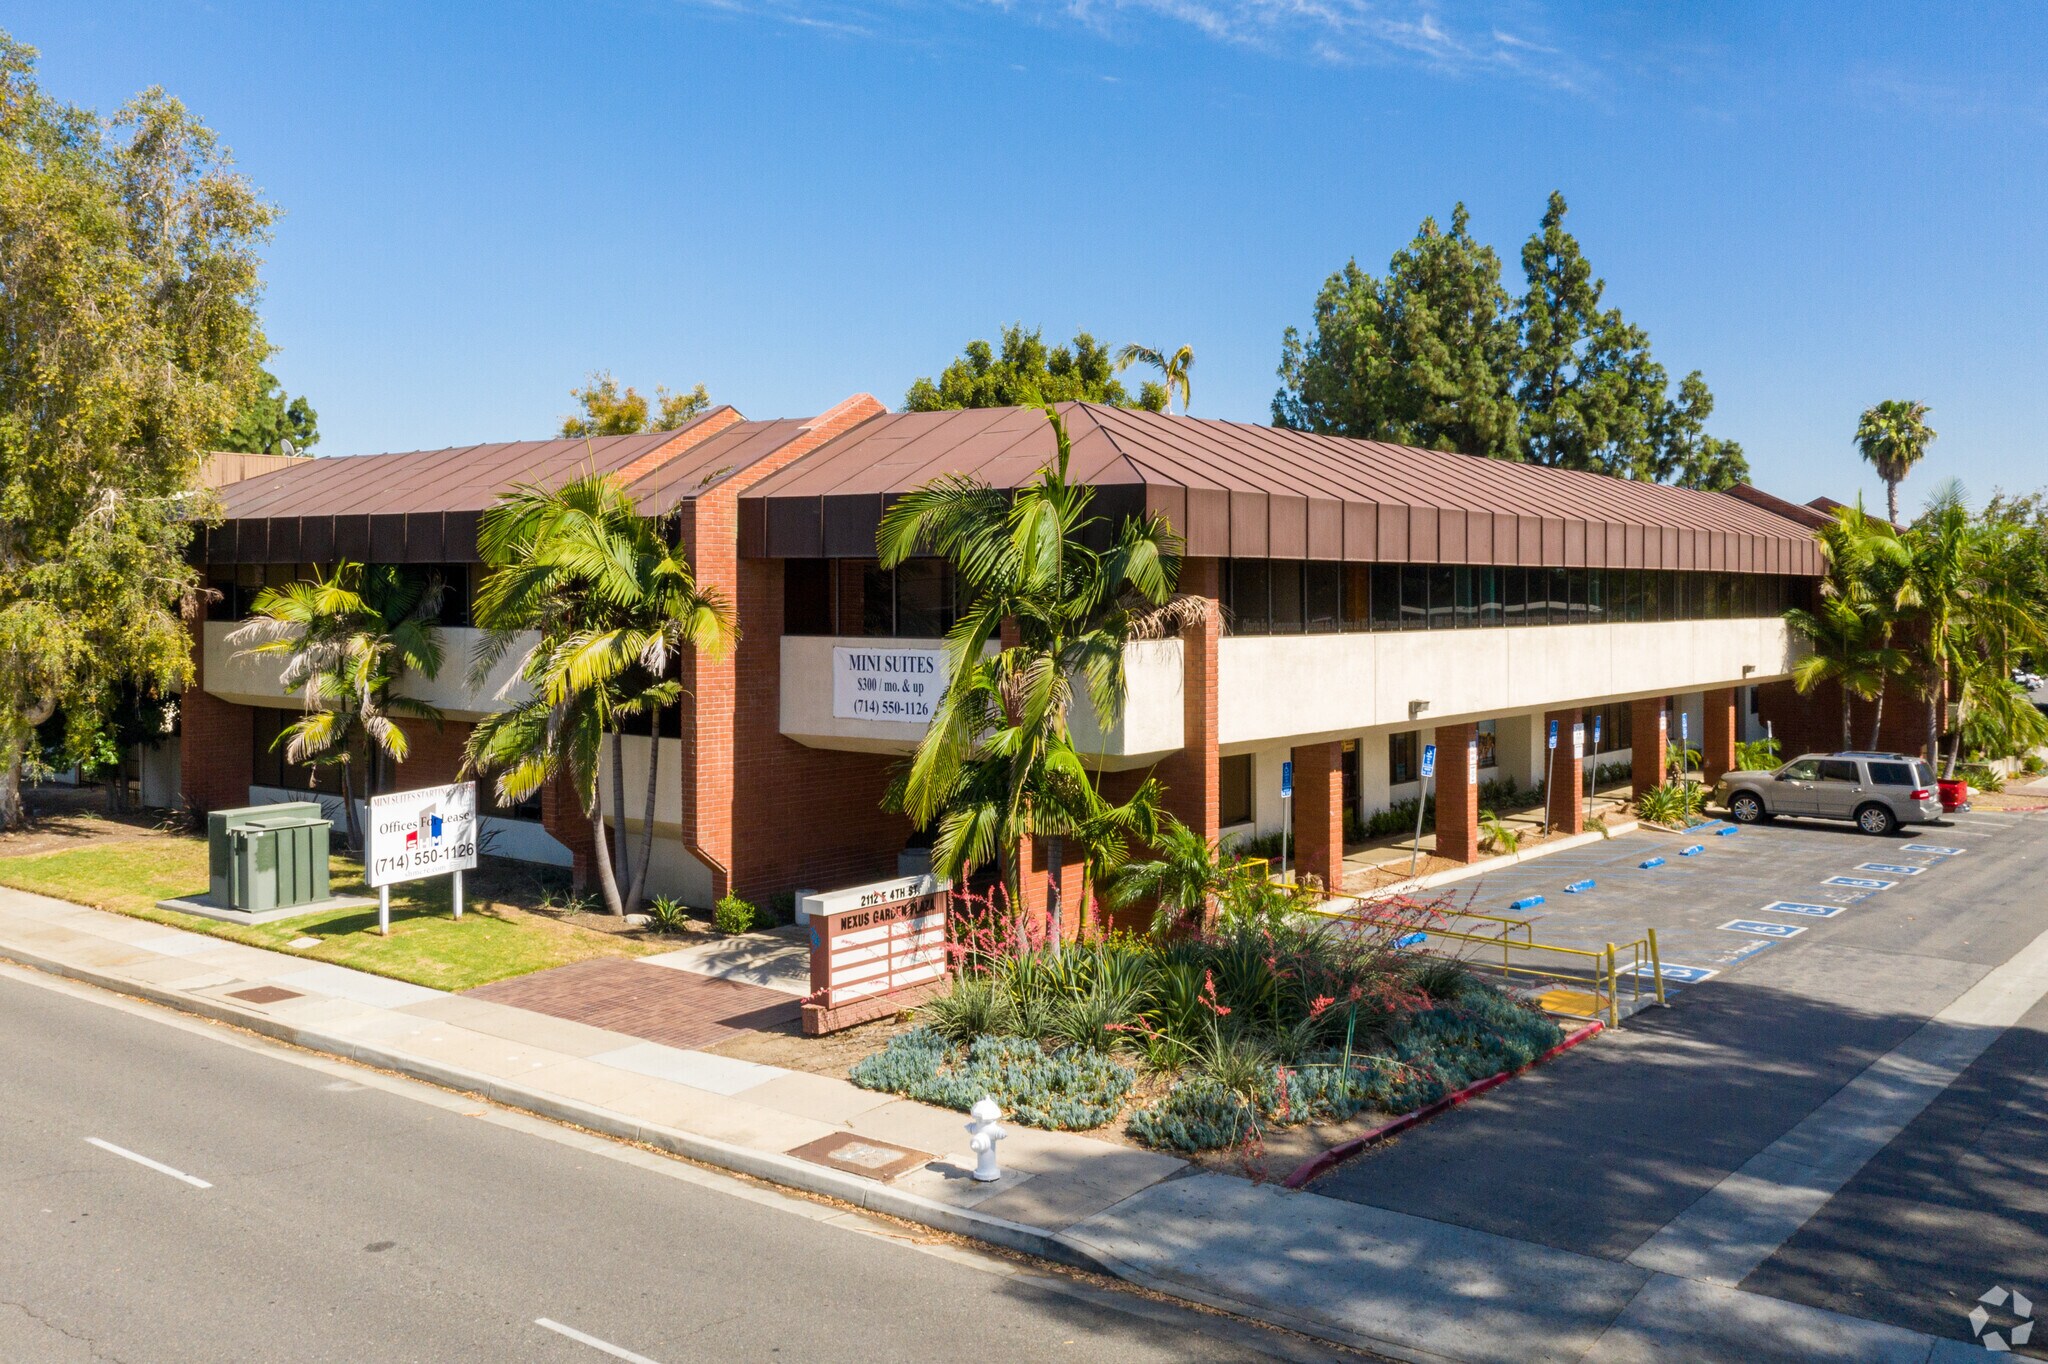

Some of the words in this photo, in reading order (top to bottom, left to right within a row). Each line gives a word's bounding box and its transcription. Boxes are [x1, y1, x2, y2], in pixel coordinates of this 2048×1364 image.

[849, 654, 881, 672] MINI
[884, 655, 934, 673] SUITES
[857, 677, 877, 691] $300
[884, 682, 900, 692] mo.
[902, 679, 910, 693] &
[913, 683, 924, 696] up
[853, 699, 880, 715] (714)
[882, 700, 928, 715] 550-1126
[373, 797, 390, 807] MINI
[391, 793, 416, 805] SUITES
[380, 820, 418, 835] Offices
[420, 816, 437, 827] For
[442, 812, 470, 824] Lease
[375, 853, 409, 876] (714)
[414, 842, 474, 866] 550-1126
[861, 893, 879, 907] 2112
[890, 887, 906, 900] 4TH
[841, 912, 870, 931] NEXUS
[909, 898, 936, 917] PLAZA
